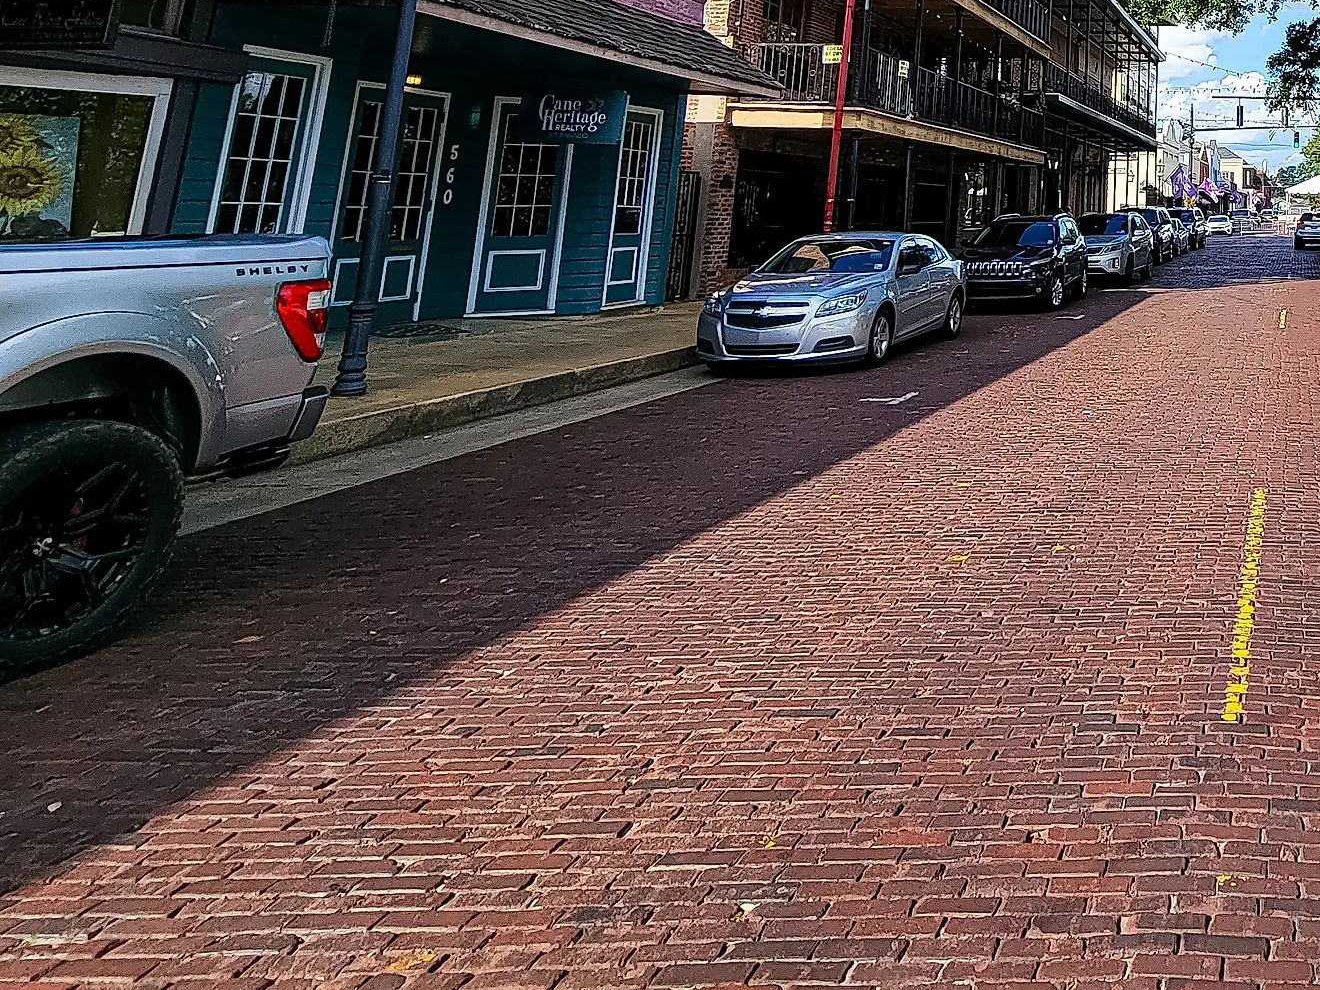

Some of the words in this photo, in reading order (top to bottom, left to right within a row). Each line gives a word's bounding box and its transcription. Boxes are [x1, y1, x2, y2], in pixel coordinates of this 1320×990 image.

[539, 94, 582, 121] Cane
[541, 109, 607, 132] Heritage
[555, 123, 587, 132] REALTY
[235, 264, 310, 277] SHELBY
